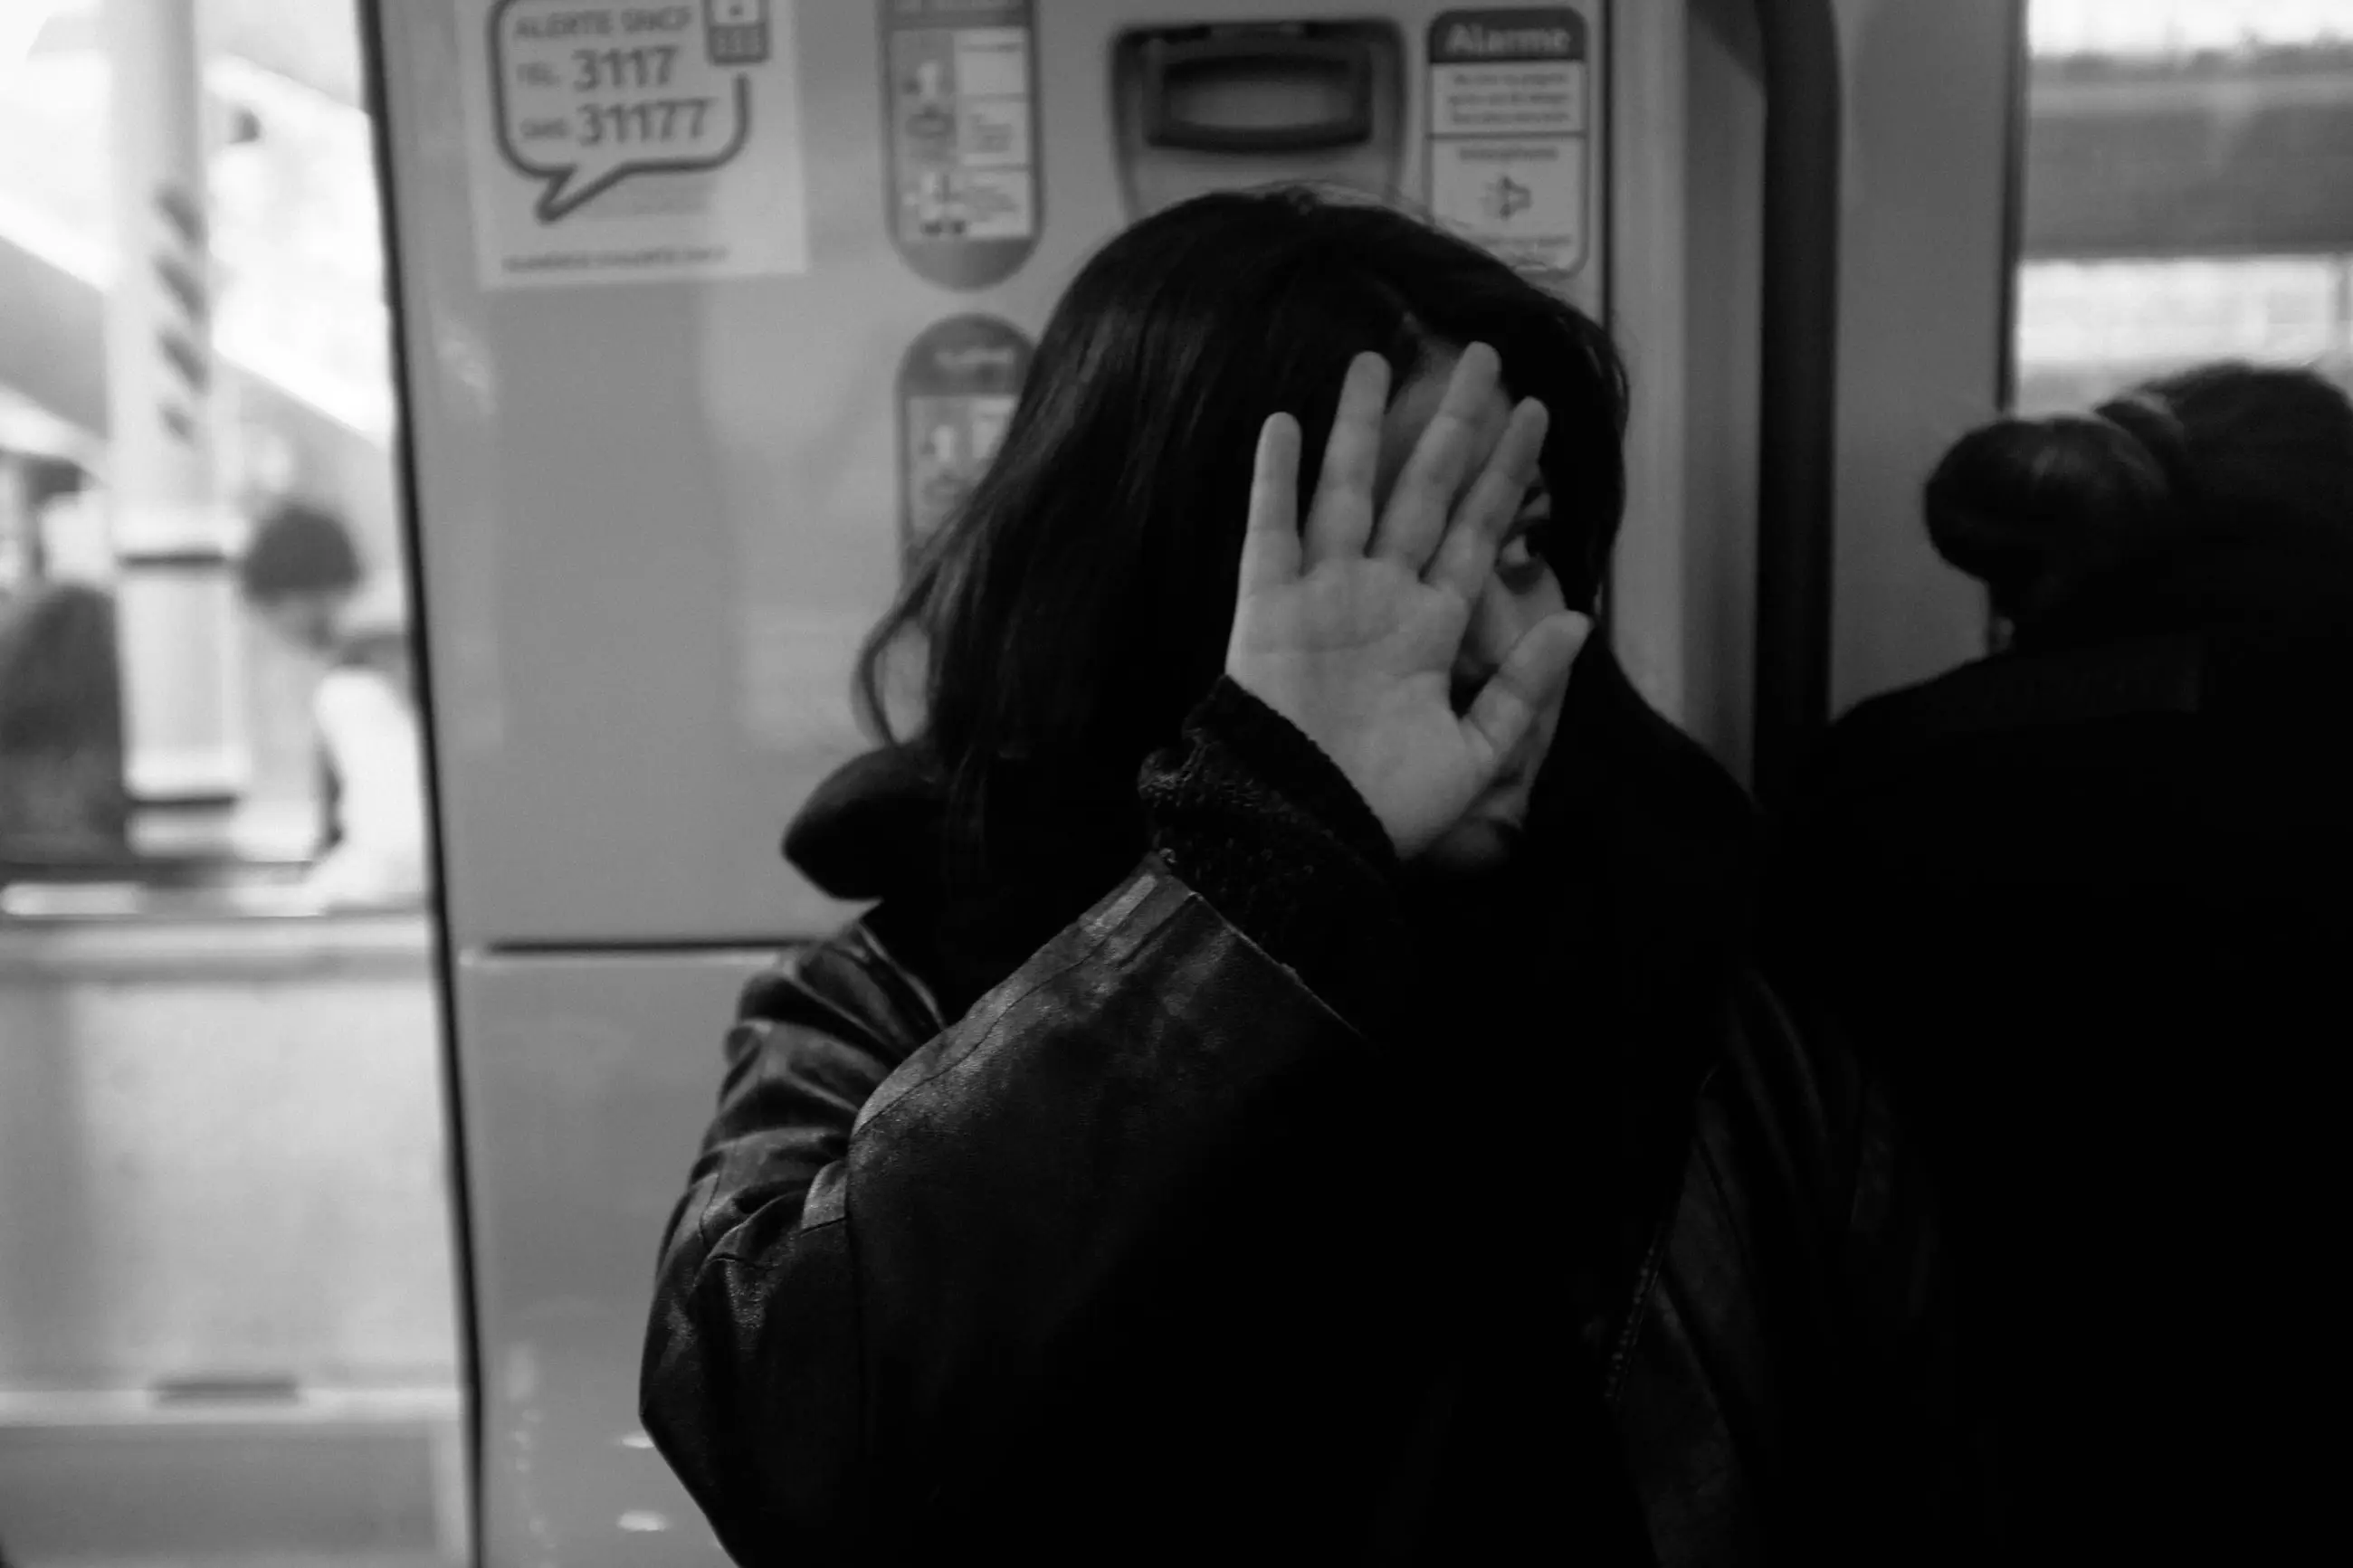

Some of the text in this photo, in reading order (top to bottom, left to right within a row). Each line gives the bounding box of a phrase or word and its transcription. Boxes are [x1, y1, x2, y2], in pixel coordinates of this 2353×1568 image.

[515, 11, 613, 37] ALERTE
[1446, 24, 1572, 54] Alarme
[571, 45, 676, 90] 3117
[576, 97, 714, 145] 31177
